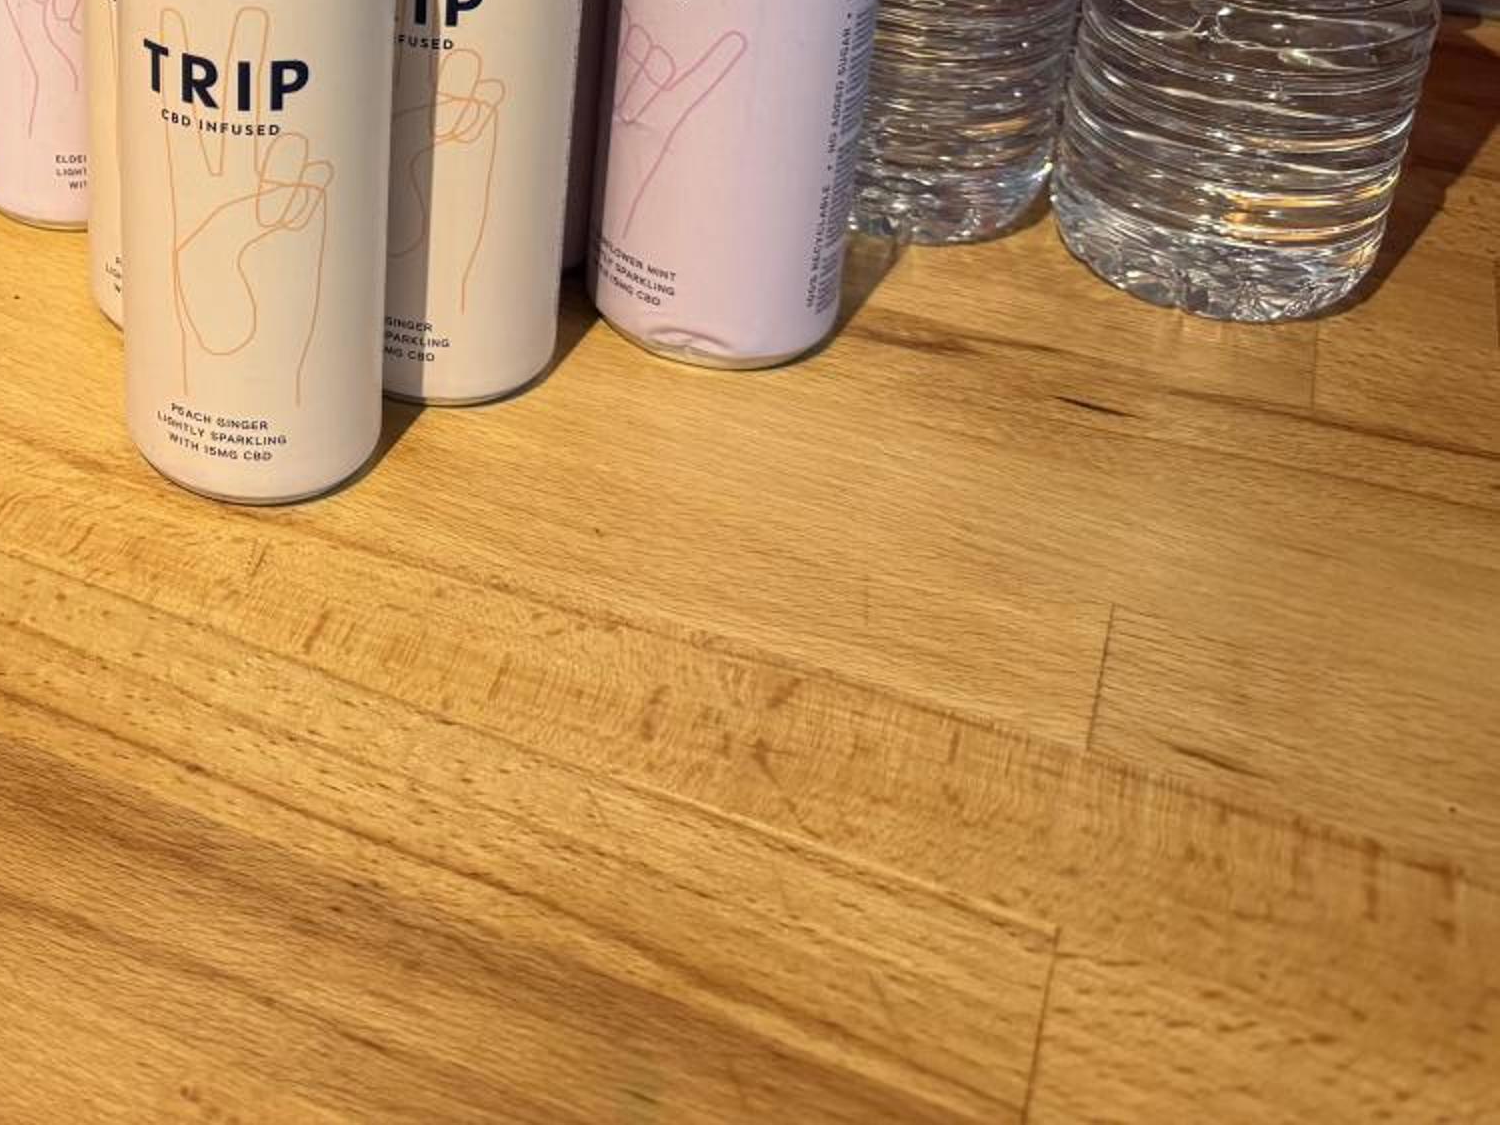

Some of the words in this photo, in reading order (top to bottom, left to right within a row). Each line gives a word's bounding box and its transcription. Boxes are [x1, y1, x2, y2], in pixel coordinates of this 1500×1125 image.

[143, 37, 310, 112] TRIP
[161, 108, 191, 126] CBD
[199, 118, 281, 136] INFUSED
[636, 289, 661, 306] CBD
[384, 330, 450, 348] PARKLING
[157, 410, 205, 438] LIGHTLY
[210, 430, 287, 446] SPARKLING
[171, 402, 212, 424] PEACH
[216, 417, 269, 431] GINGER
[169, 432, 200, 452] WITH
[203, 444, 238, 460] 15MG
[243, 450, 274, 461] CBD
